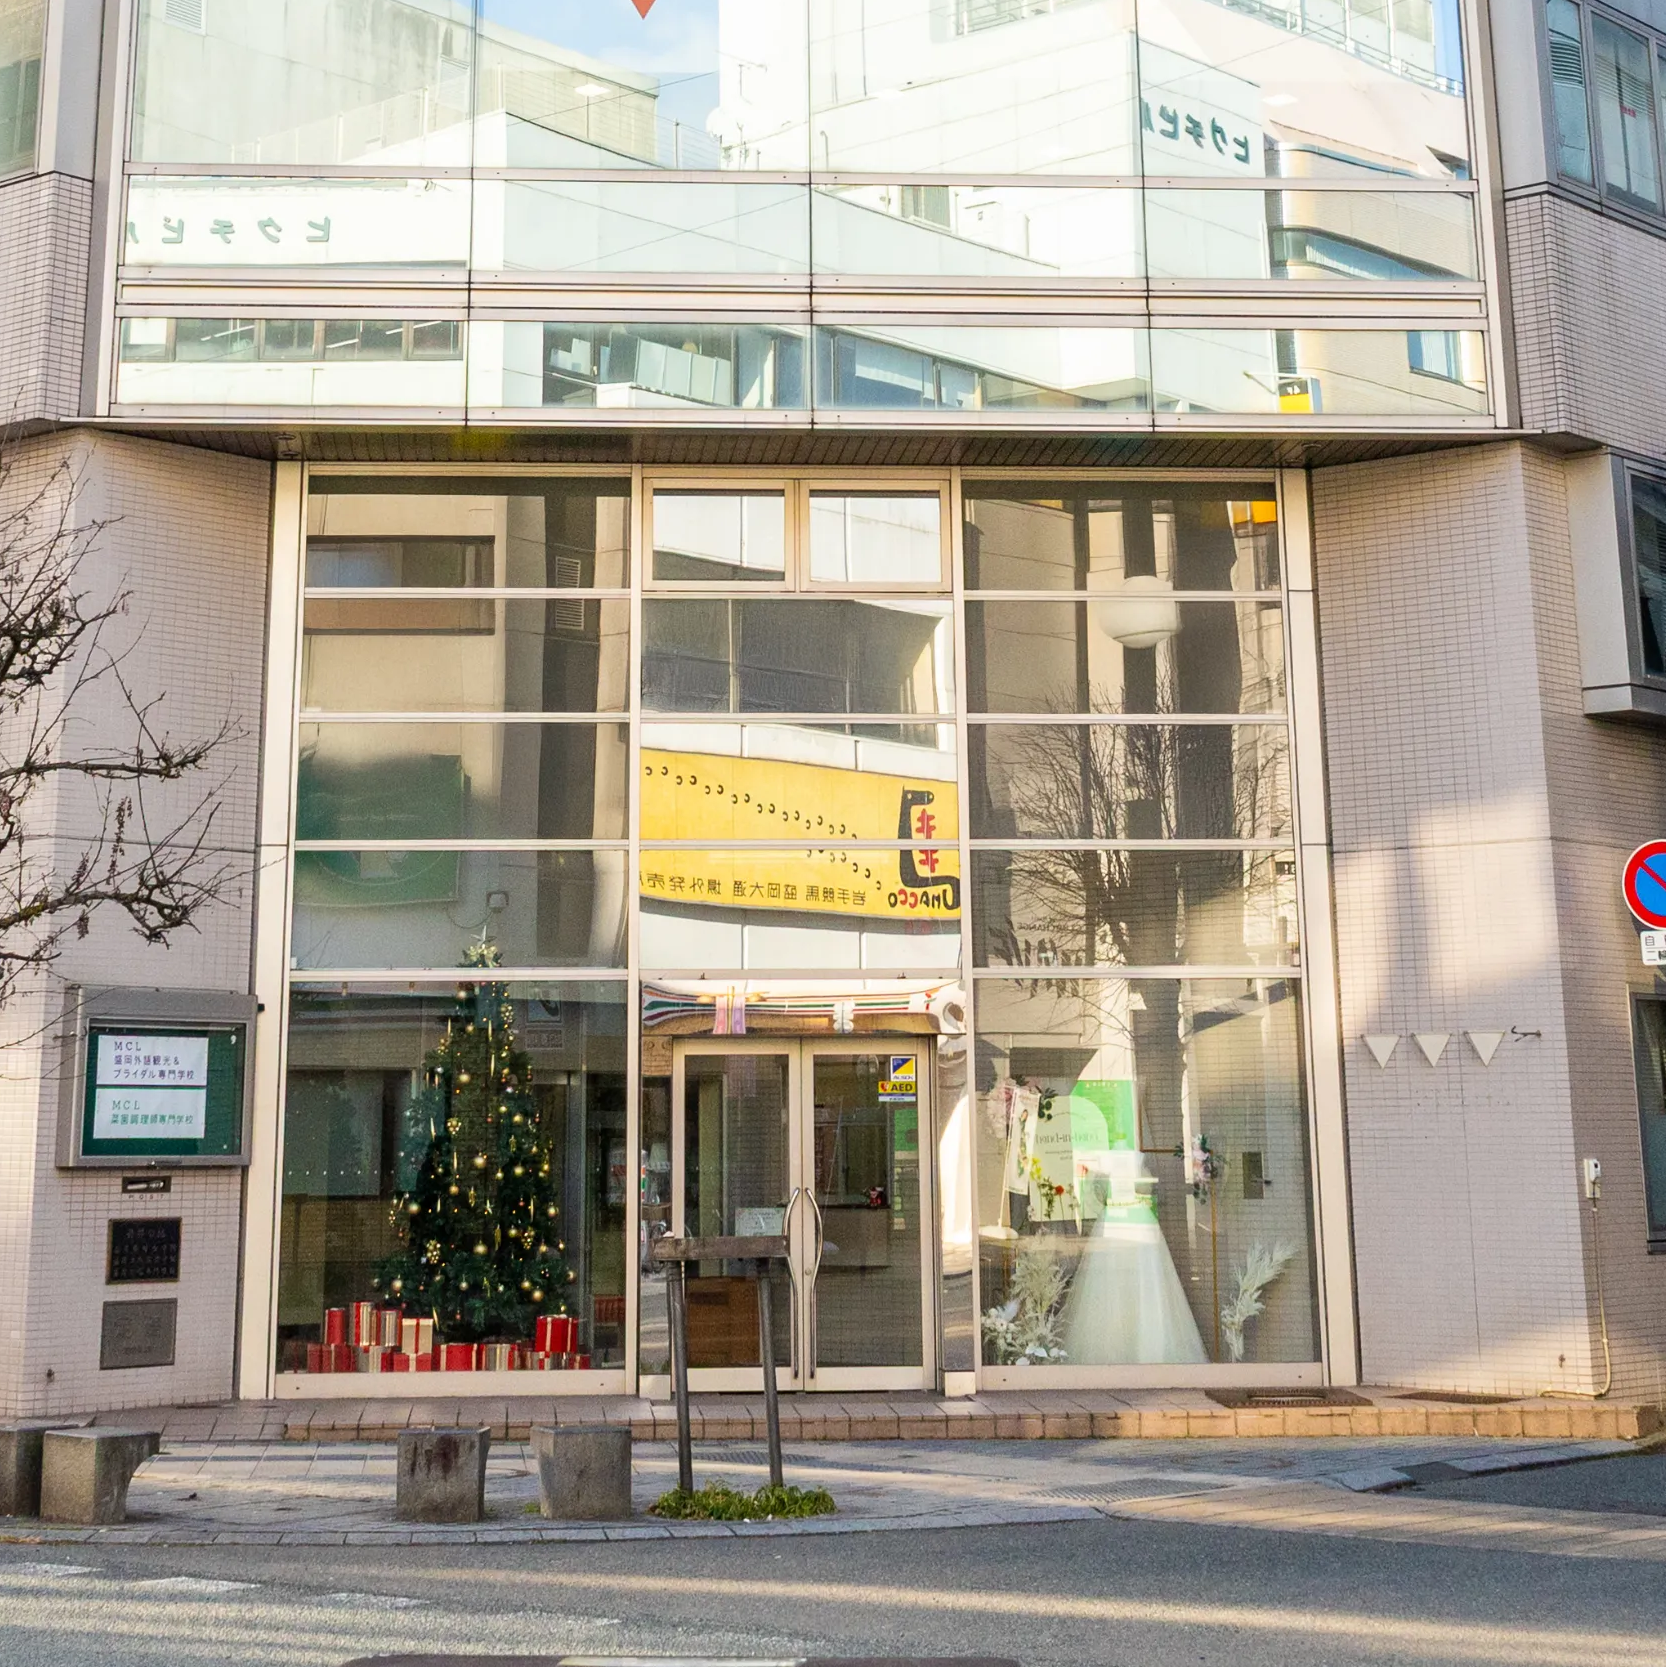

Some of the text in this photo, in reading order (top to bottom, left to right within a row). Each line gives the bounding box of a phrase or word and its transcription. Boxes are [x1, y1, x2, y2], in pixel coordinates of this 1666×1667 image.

[112, 1068, 196, 1081] ブライダル専門学校
[890, 1083, 914, 1092] AED
